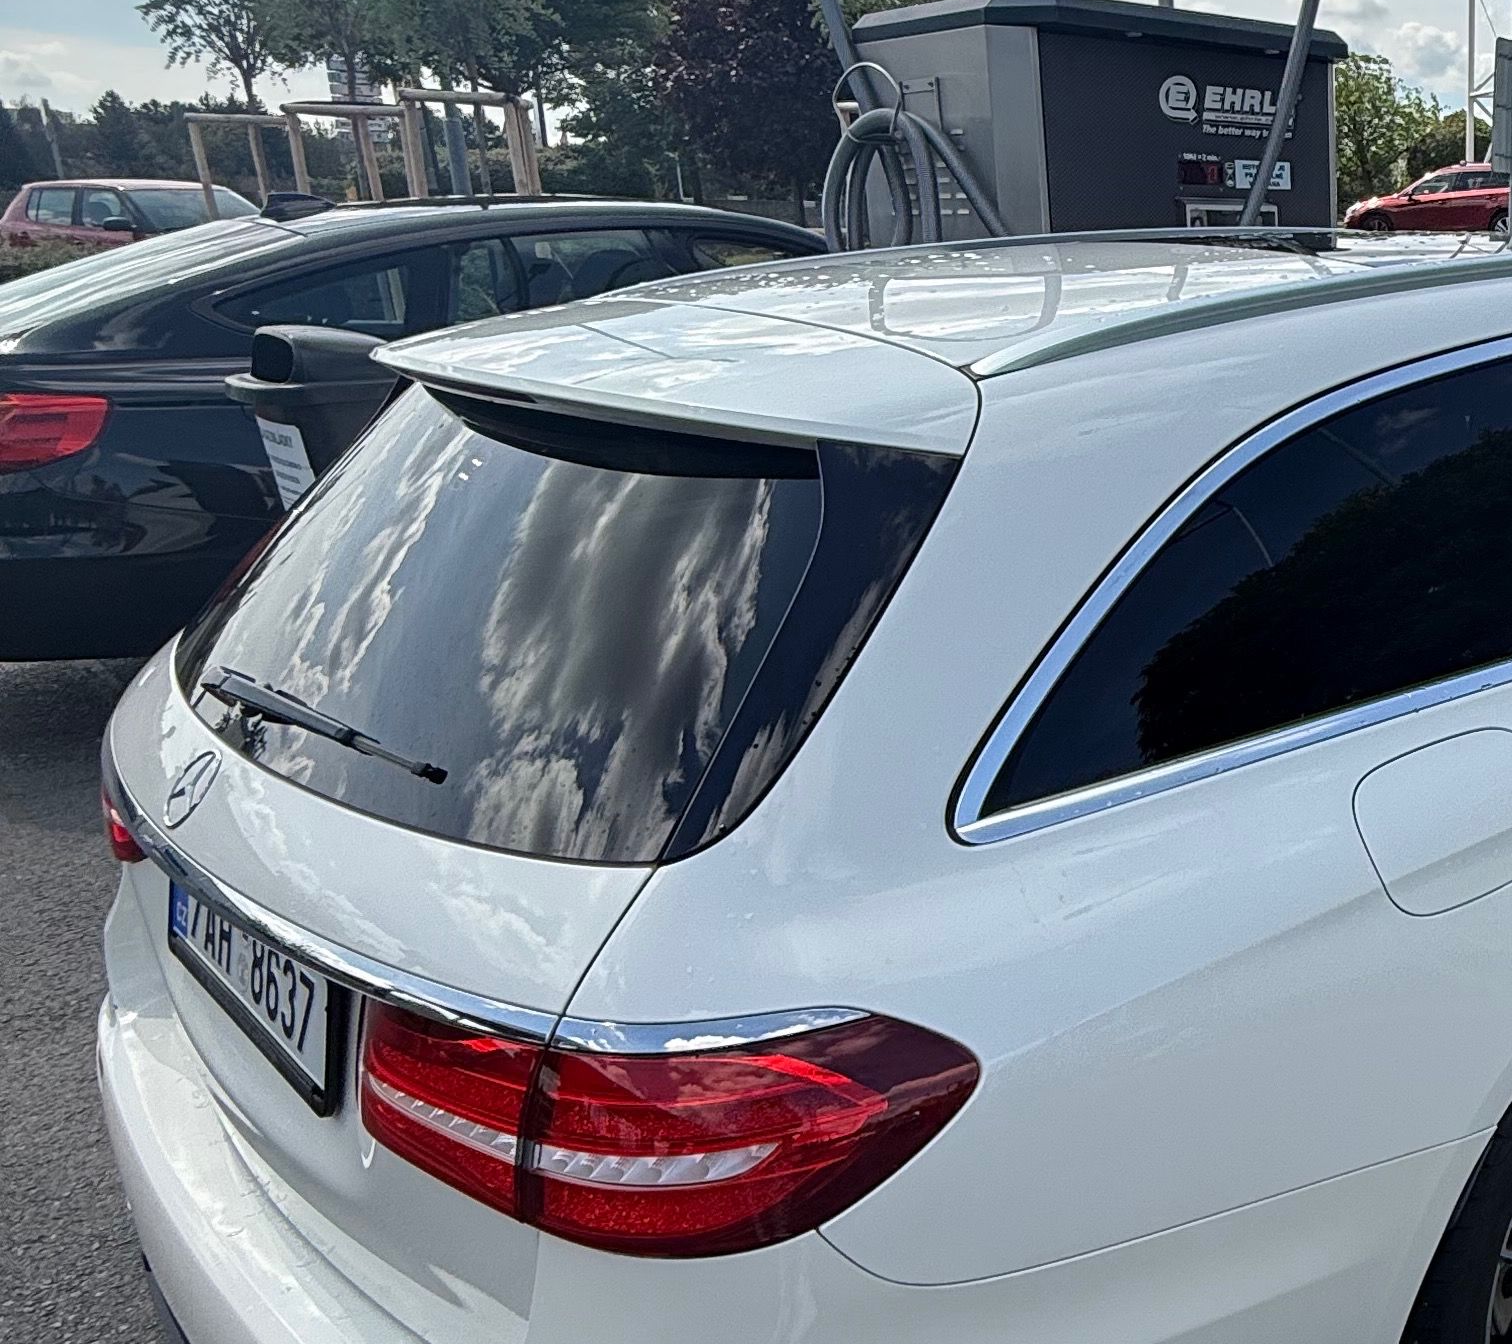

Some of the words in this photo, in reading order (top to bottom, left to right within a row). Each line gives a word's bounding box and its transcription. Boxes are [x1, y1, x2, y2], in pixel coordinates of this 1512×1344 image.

[1203, 85, 1277, 114] EHRL
[1203, 124, 1217, 134] The
[1218, 126, 1243, 136] better
[1244, 129, 1262, 139] way
[176, 900, 187, 927] CZ
[250, 939, 315, 1054] 8637
